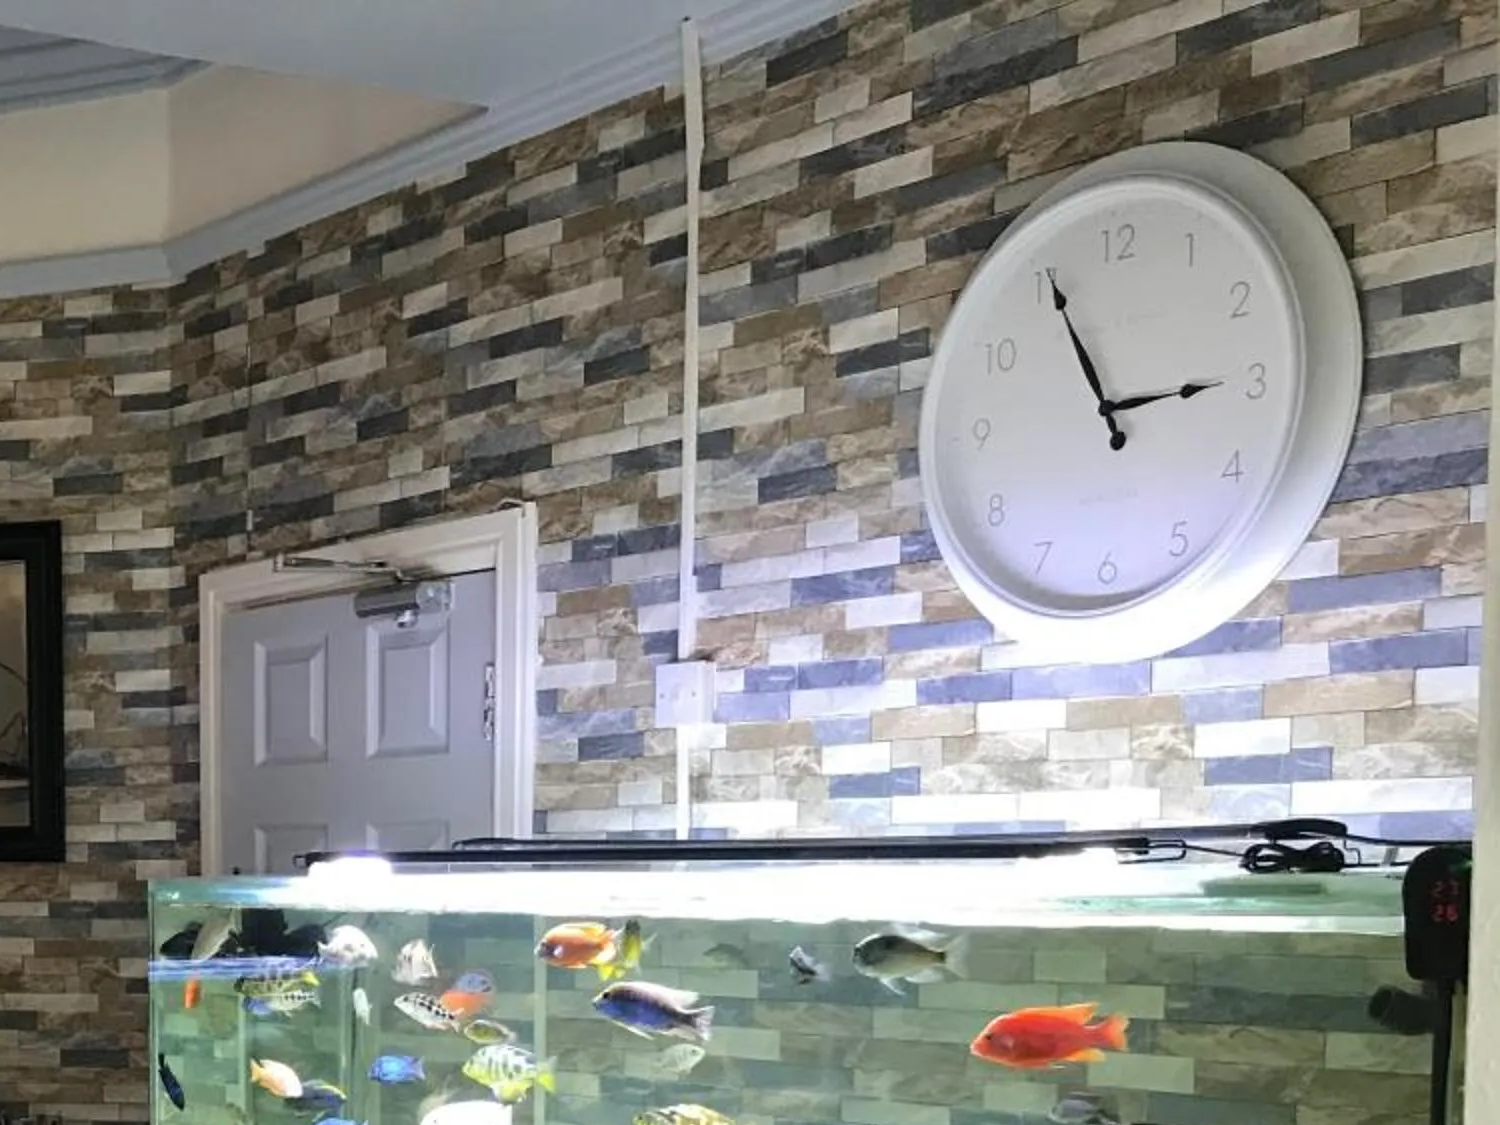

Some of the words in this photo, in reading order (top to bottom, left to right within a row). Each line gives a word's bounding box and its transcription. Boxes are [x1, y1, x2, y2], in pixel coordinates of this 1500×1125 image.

[1101, 223, 1137, 264] 12
[1184, 232, 1195, 267] 1
[1229, 280, 1252, 320] 2
[984, 337, 1017, 377] 10
[1245, 363, 1267, 400] 3
[972, 418, 992, 451] 9
[1220, 450, 1245, 485] 4
[987, 493, 1006, 528] 8
[1167, 520, 1191, 558] 5
[1034, 540, 1053, 576] 7
[1097, 550, 1119, 586] 6
